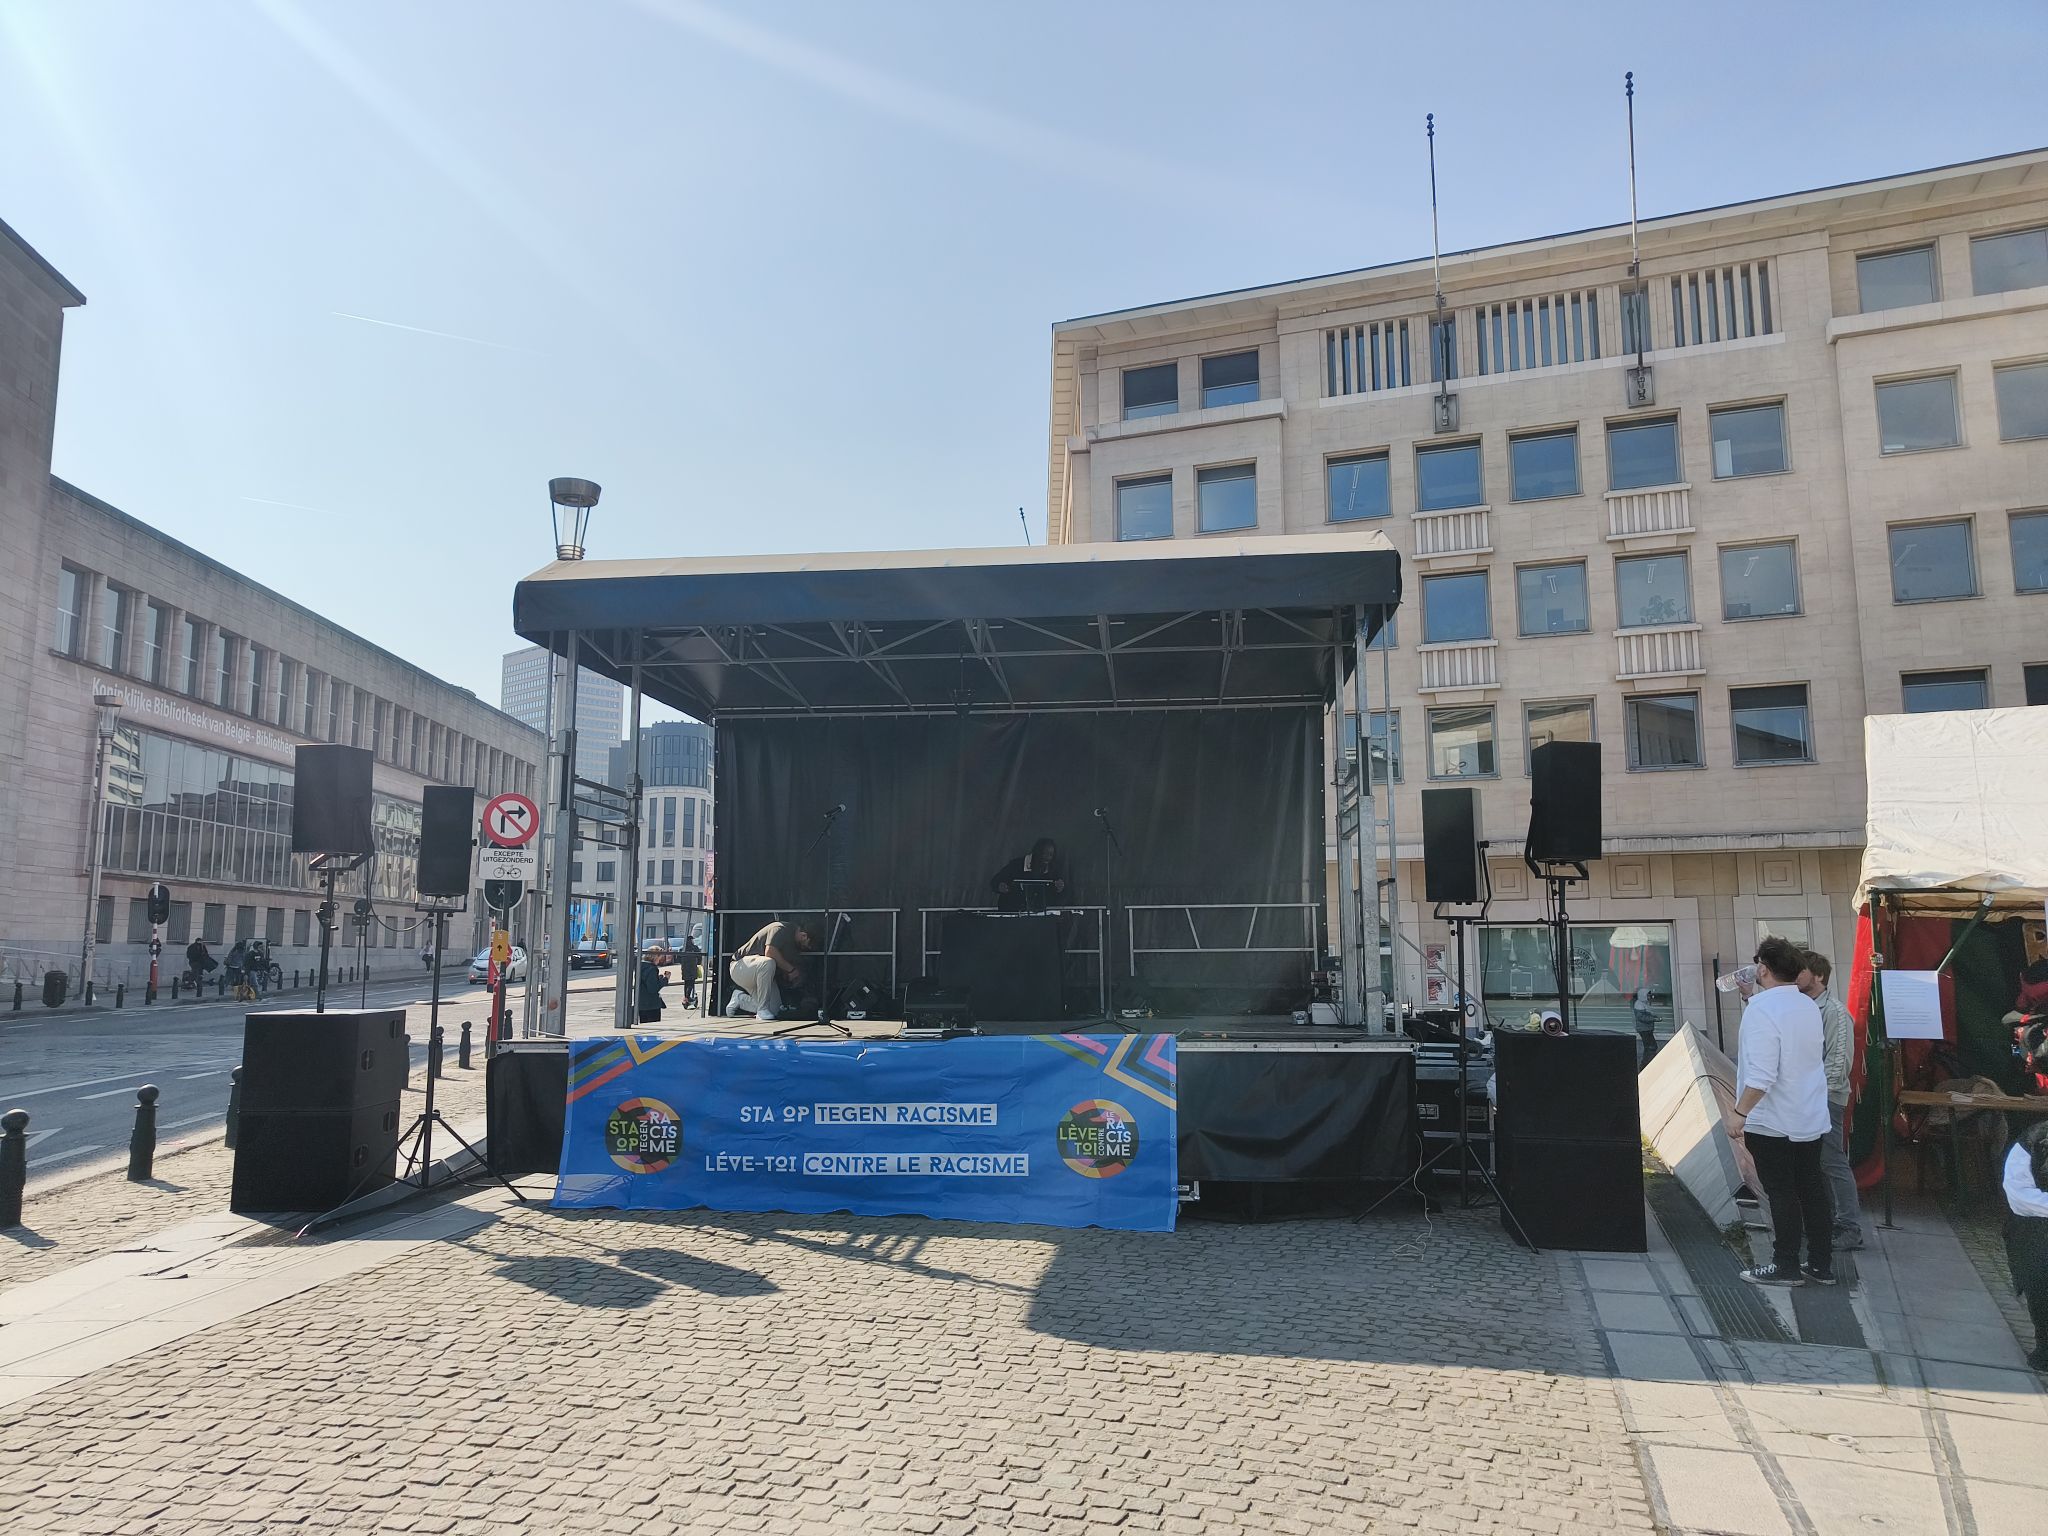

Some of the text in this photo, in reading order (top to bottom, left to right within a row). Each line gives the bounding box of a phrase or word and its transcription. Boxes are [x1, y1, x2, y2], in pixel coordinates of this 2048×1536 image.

[153, 696, 209, 731] Bibliotheek
[209, 719, 225, 736] van
[225, 723, 250, 745] België
[649, 1111, 671, 1124] RA
[740, 1105, 993, 1124] STA OP TEGEN RACISME
[609, 1121, 639, 1134] STA
[1106, 1118, 1125, 1129] RA
[639, 1120, 648, 1152] TEGEN
[649, 1126, 677, 1138] CIS
[1060, 1124, 1097, 1140] LÈVE
[1106, 1130, 1132, 1143] CIS
[617, 1138, 638, 1151] OP
[649, 1140, 675, 1152] ME
[1074, 1143, 1097, 1155] TOI
[1106, 1144, 1131, 1157] ME
[804, 1156, 888, 1173] CONTRE
[896, 1157, 921, 1173] LE
[929, 1157, 1026, 1174] RACISME
